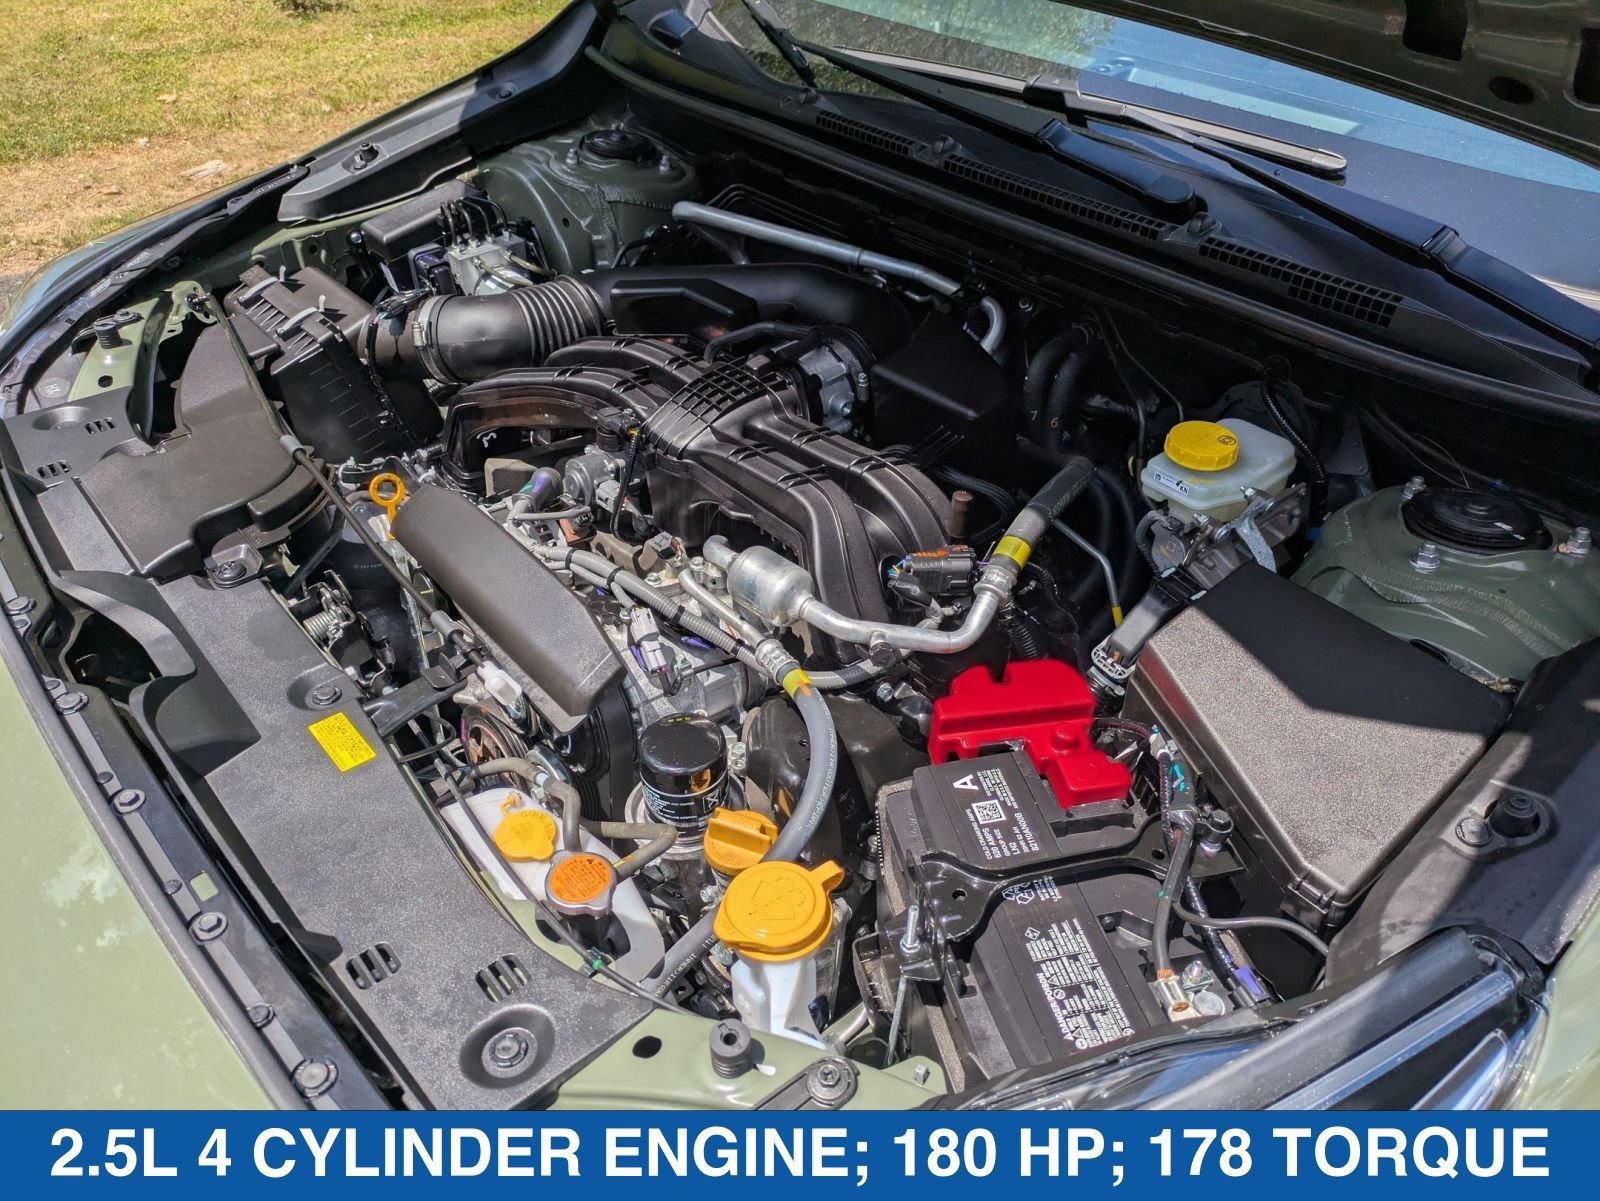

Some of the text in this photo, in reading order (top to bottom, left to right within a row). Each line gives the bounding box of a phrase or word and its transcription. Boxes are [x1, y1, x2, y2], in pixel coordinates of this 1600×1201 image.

[953, 774, 979, 790] A
[966, 809, 993, 860] COLD CRANKING AMPS
[983, 828, 1002, 859] 620 AMPS
[994, 829, 1011, 857] GROUP SIZE
[1009, 842, 1020, 855] LN2
